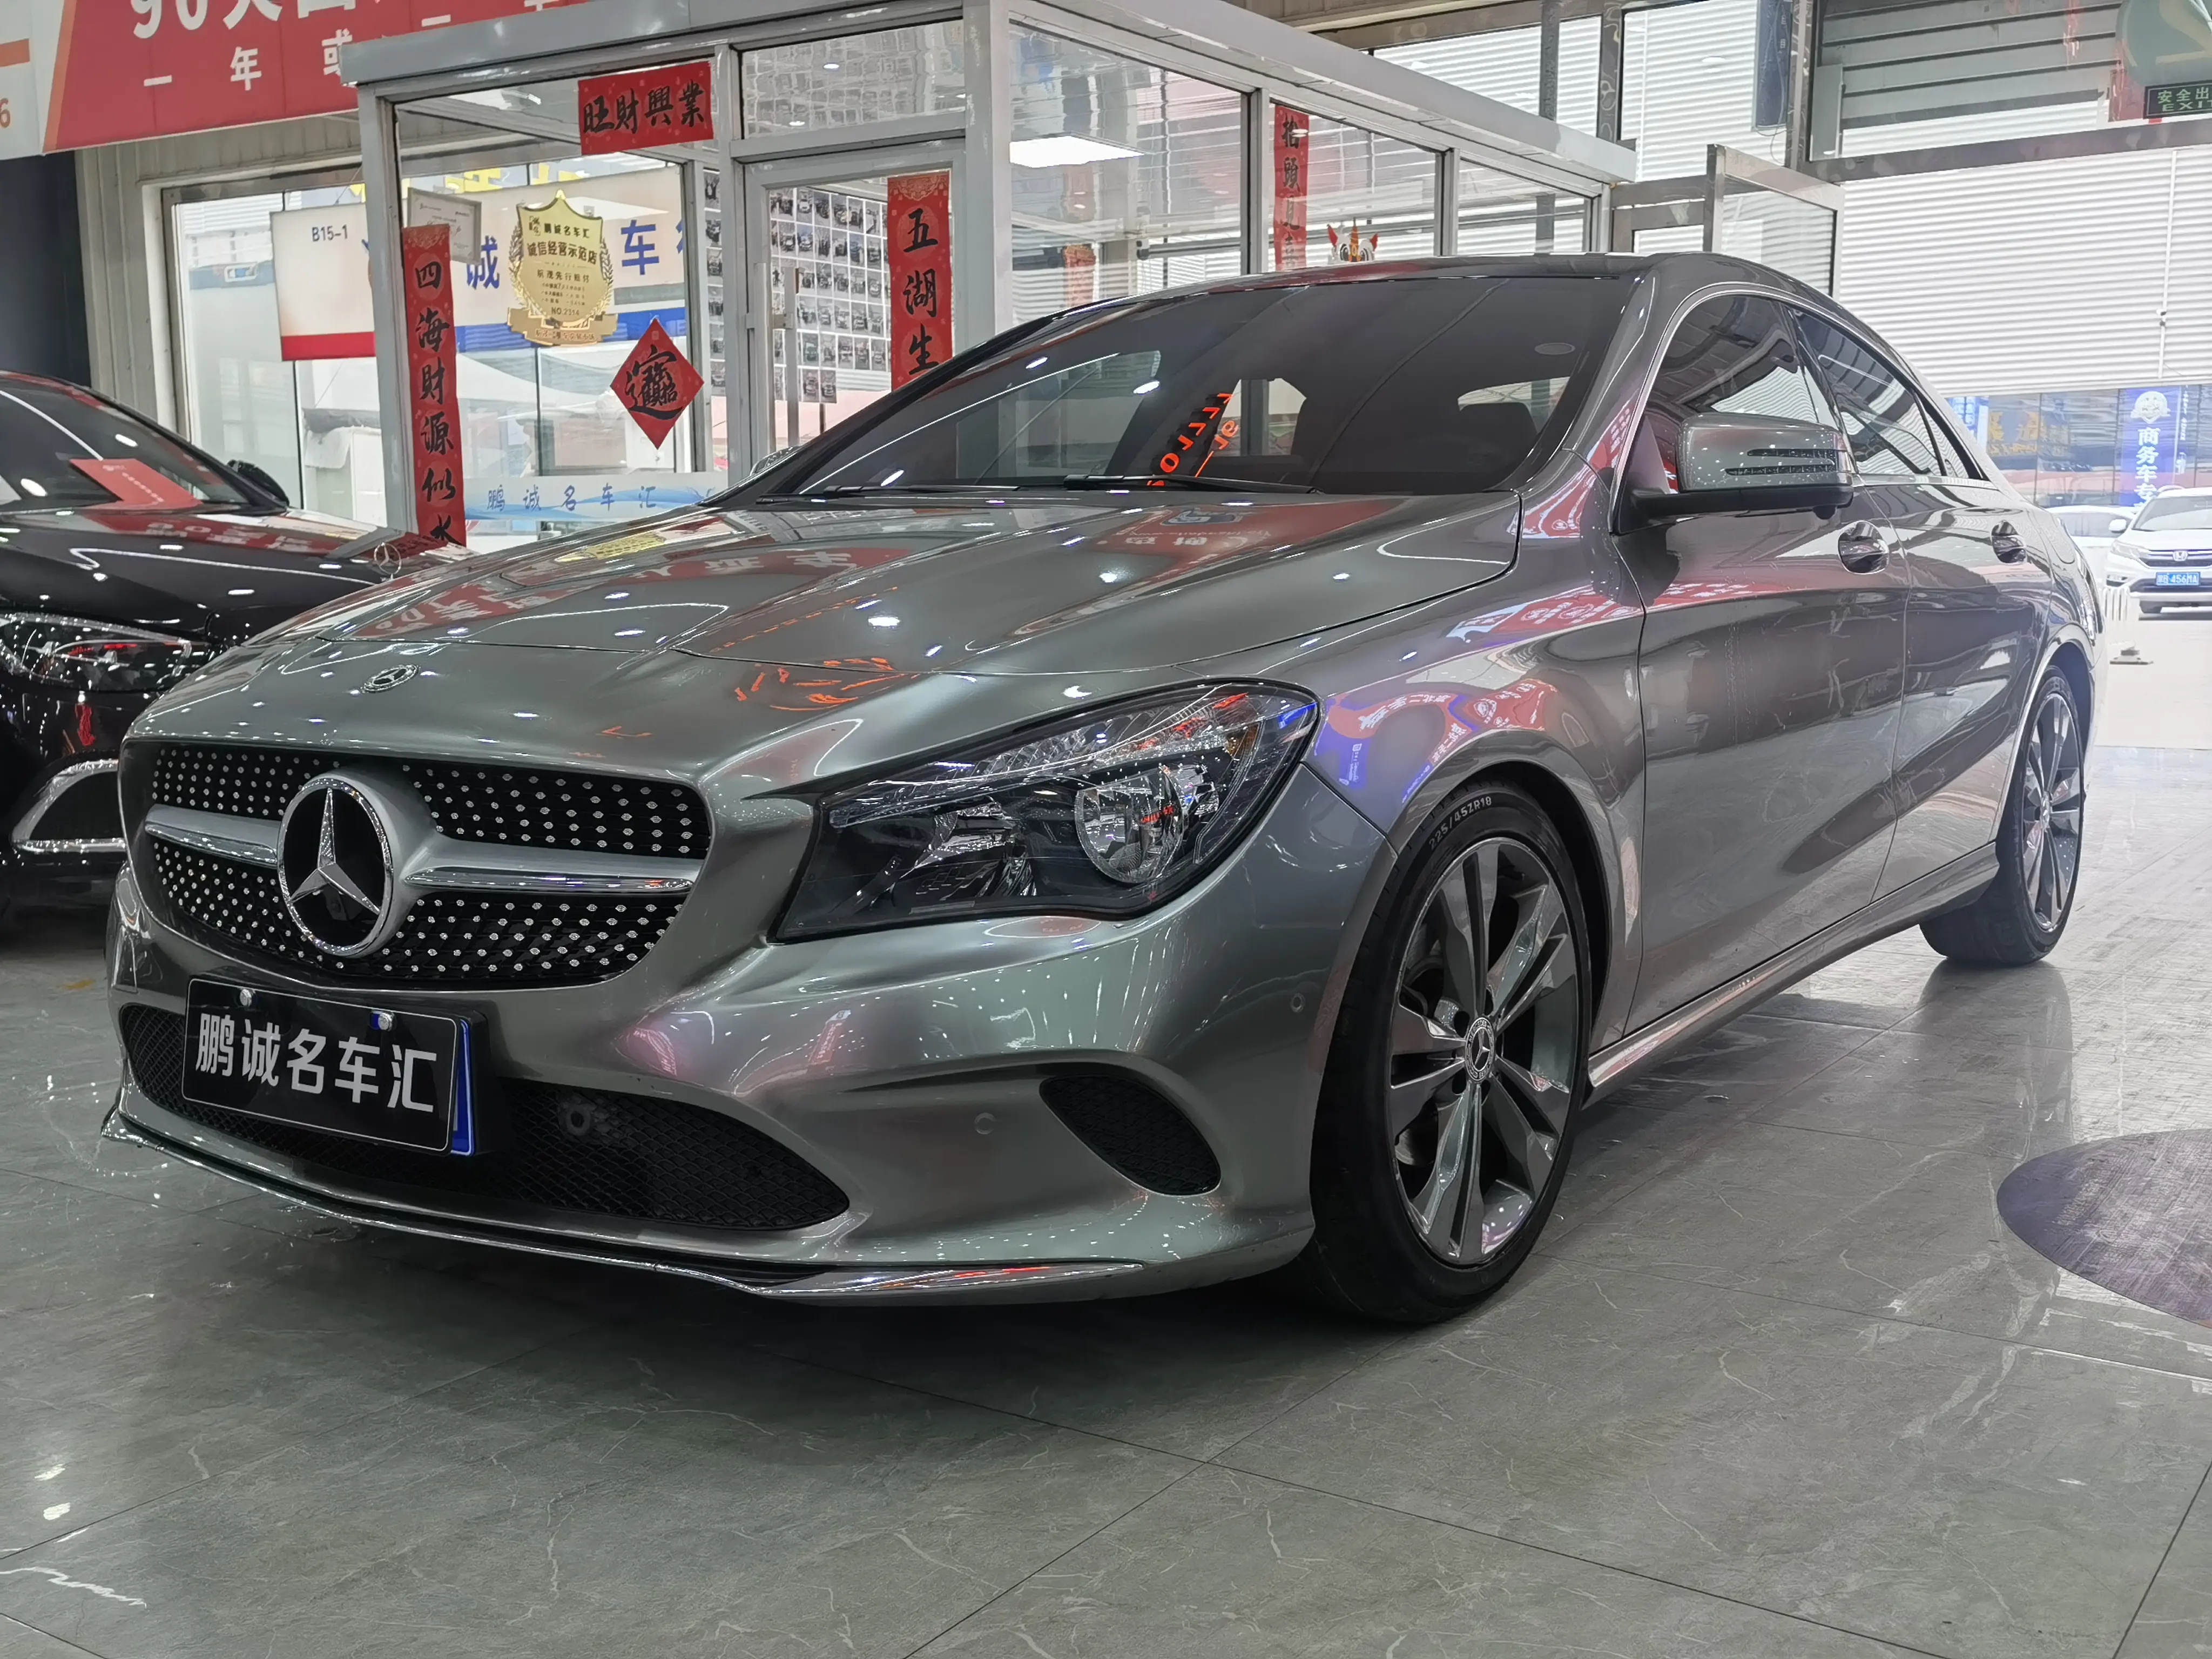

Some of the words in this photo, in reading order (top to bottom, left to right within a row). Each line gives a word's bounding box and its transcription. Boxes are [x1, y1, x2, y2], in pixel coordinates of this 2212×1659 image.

[312, 225, 348, 242] B15-1
[527, 240, 598, 265] 诚信经营示范店
[2133, 427, 2161, 510] 商务车专
[487, 482, 656, 512] 鹏诚名车汇
[1429, 796, 1492, 851] 225/45ZR18
[195, 1013, 437, 1113] 鹏诚名车汇
